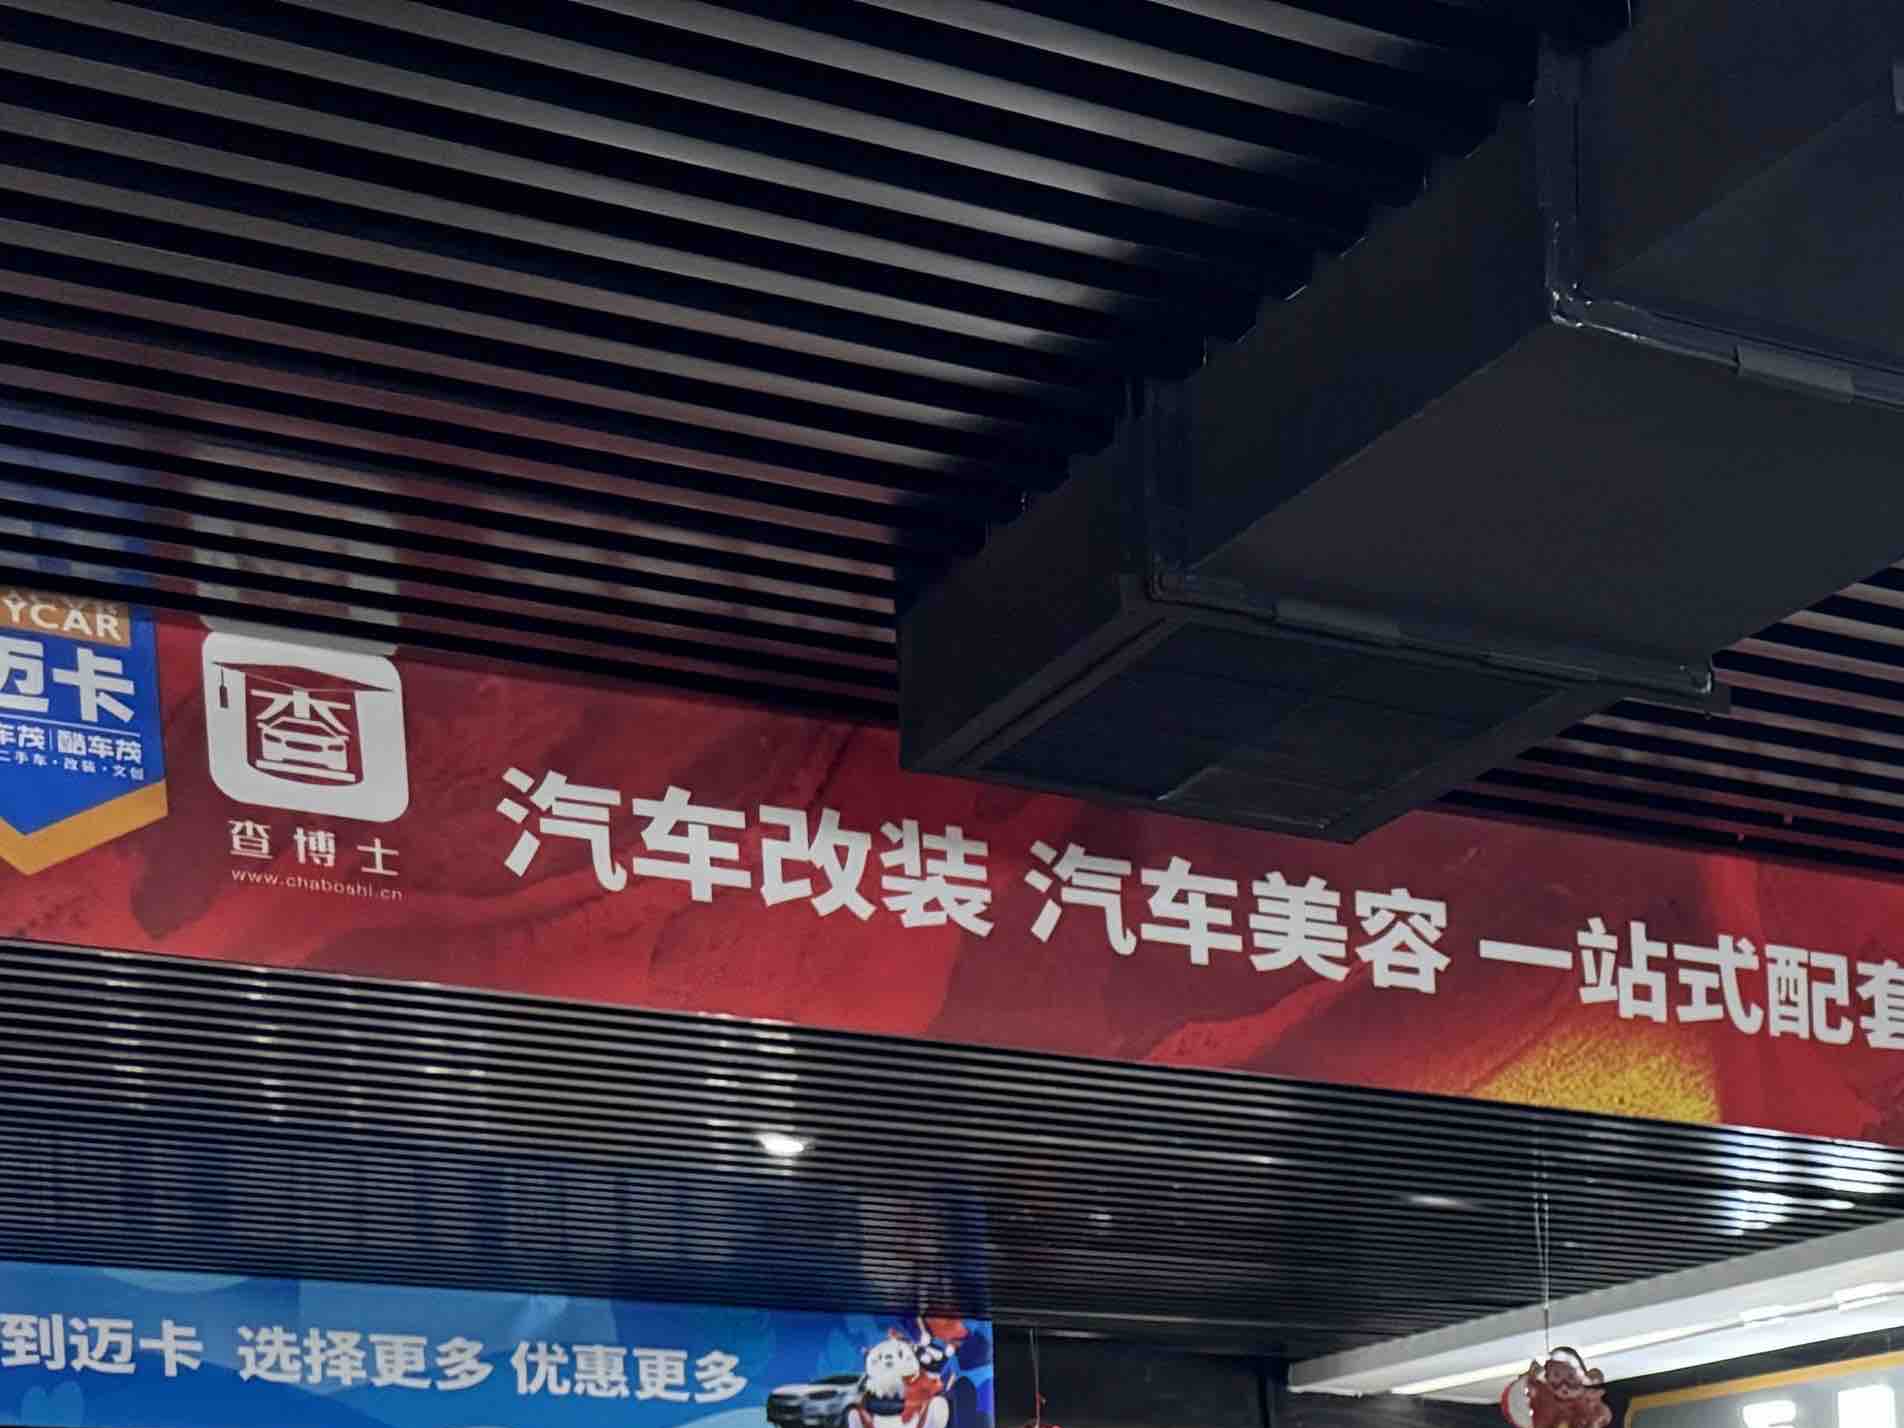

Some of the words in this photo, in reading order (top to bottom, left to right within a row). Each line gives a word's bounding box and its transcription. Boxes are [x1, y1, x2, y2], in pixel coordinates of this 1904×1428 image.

[228, 819, 400, 877] 查博士
[231, 867, 403, 901] www.chaboshi.cn
[495, 766, 995, 938] 汽车改装
[1026, 842, 1451, 995] 汽车美容
[0, 1311, 203, 1379] 到迈卡
[237, 1324, 494, 1392] 选择更多
[509, 1340, 749, 1404] 优惠更多
